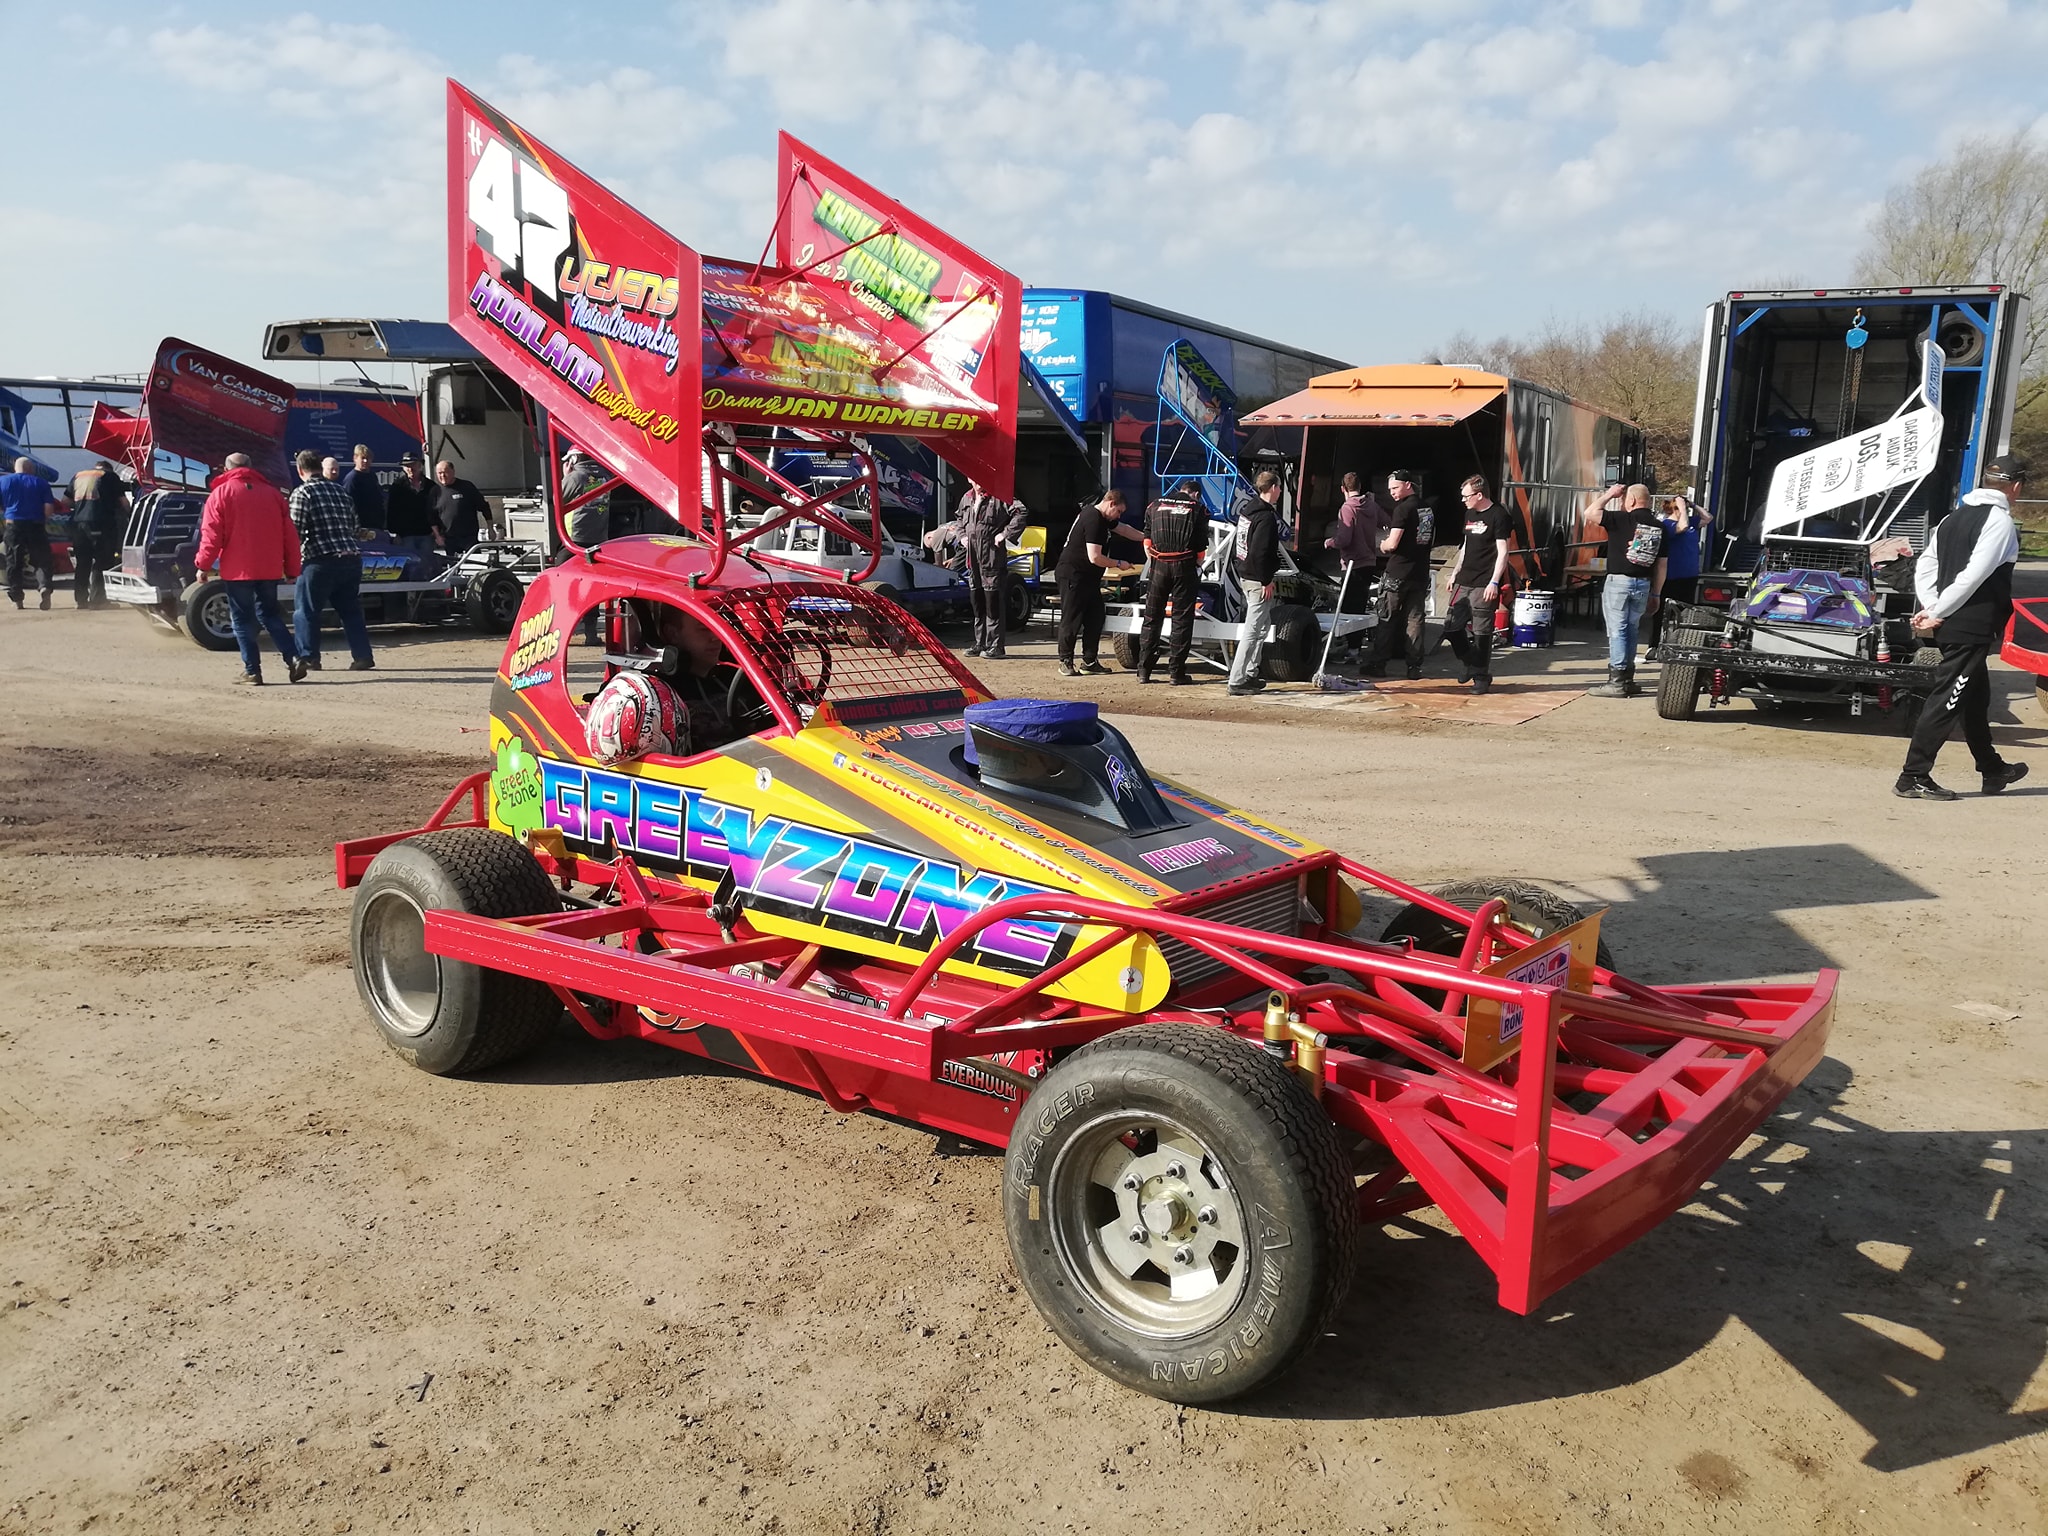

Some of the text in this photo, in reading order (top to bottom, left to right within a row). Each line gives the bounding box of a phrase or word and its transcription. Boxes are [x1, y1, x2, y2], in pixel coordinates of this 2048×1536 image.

[558, 256, 679, 316] LITJENS
[469, 270, 605, 397] HOOILAND
[569, 293, 679, 373] Metaalbewerking
[188, 358, 219, 381] VAN
[221, 374, 290, 408] CAMPEN
[589, 378, 656, 430] Vastgoed
[702, 388, 781, 415] Danny
[841, 401, 979, 431] WAMELEN
[1854, 433, 1881, 493] DGS Techniek
[1886, 436, 1900, 470] ANDIJK
[1903, 418, 1918, 474] DAKSERVICE
[1796, 466, 1813, 512] TESSELAAR
[499, 768, 531, 801] green
[507, 783, 538, 810] zone
[848, 762, 997, 842] STOCKCARTEAM
[368, 859, 443, 908] AMERIC
[1012, 1081, 1096, 1199] RACER
[1151, 1203, 1293, 1382] AMERICAN
